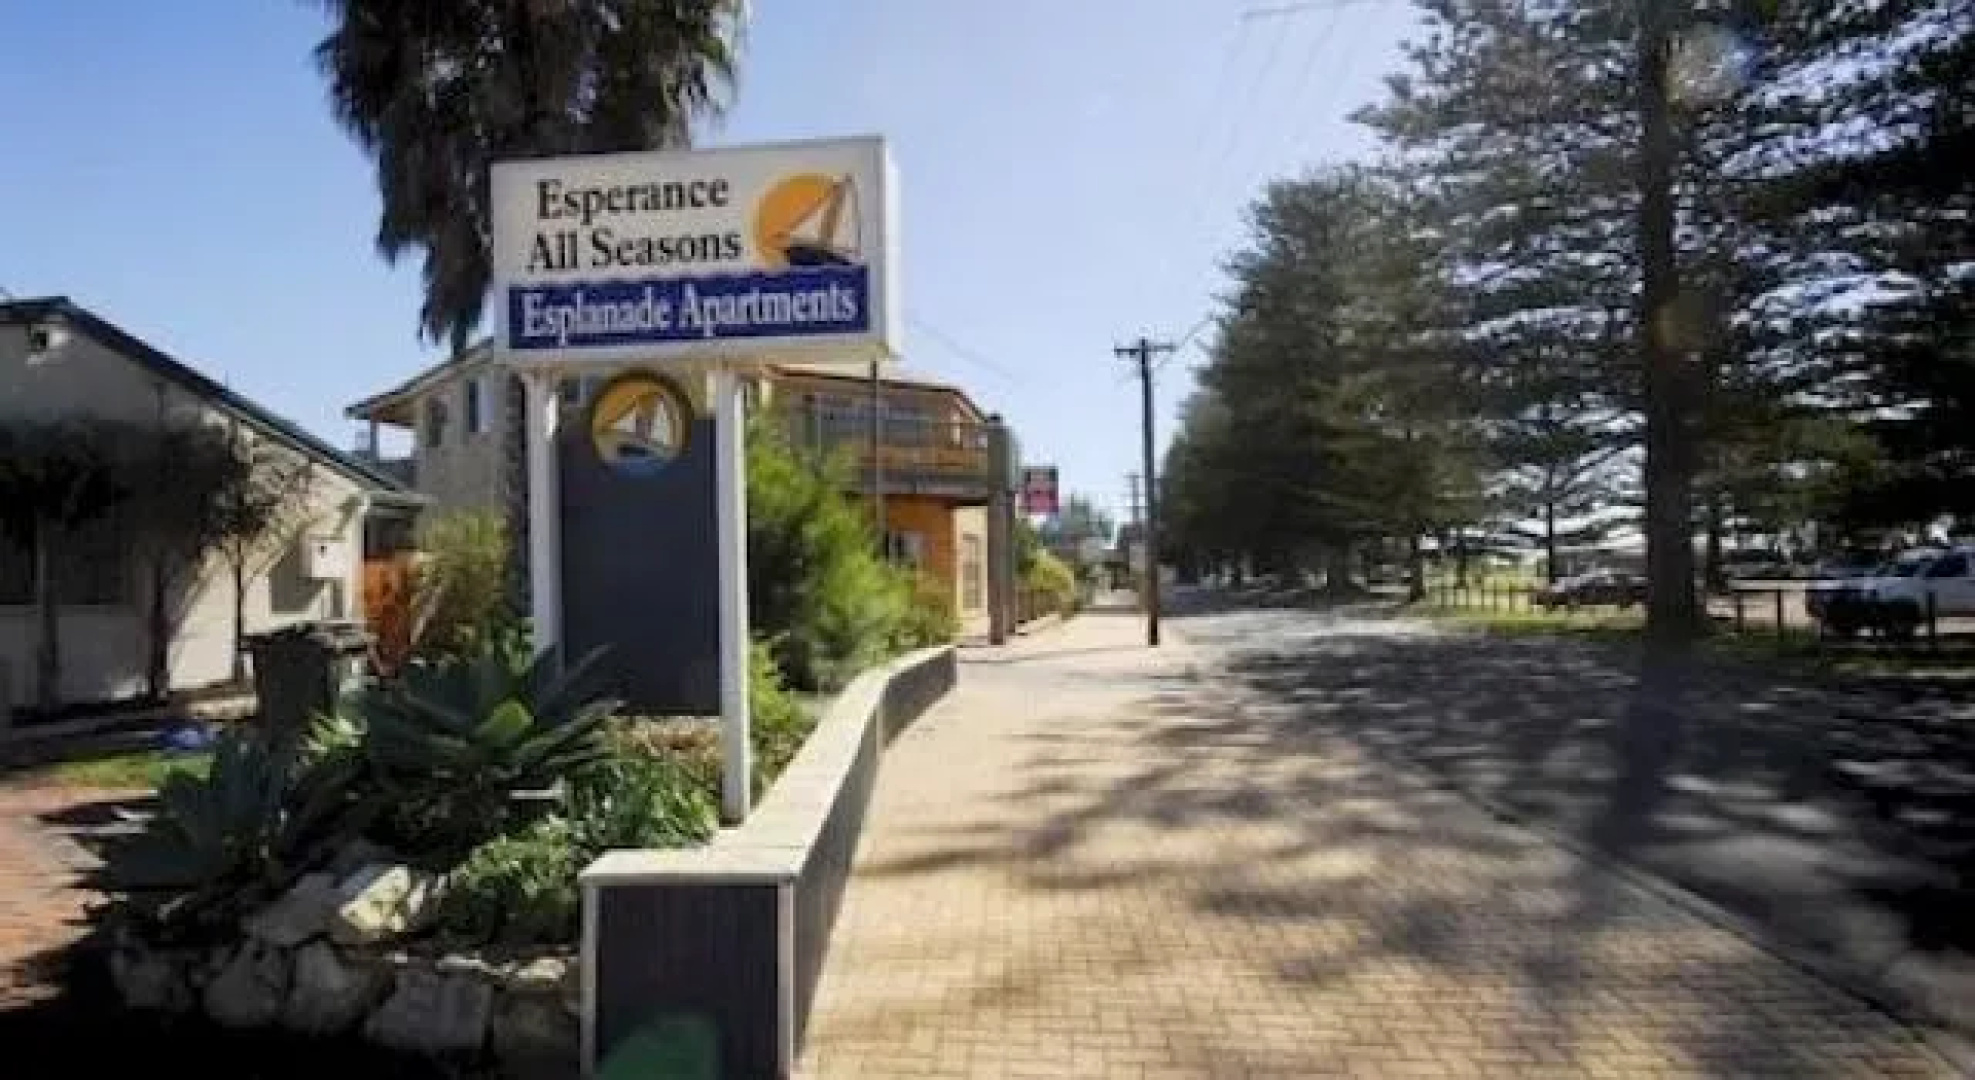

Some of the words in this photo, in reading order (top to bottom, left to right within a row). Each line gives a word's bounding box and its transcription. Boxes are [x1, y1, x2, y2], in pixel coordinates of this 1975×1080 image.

[536, 176, 729, 225] Esperance
[527, 231, 579, 271] All
[591, 226, 743, 267] Seasons
[521, 286, 671, 346] Esplanade
[679, 281, 858, 338] Apartments
